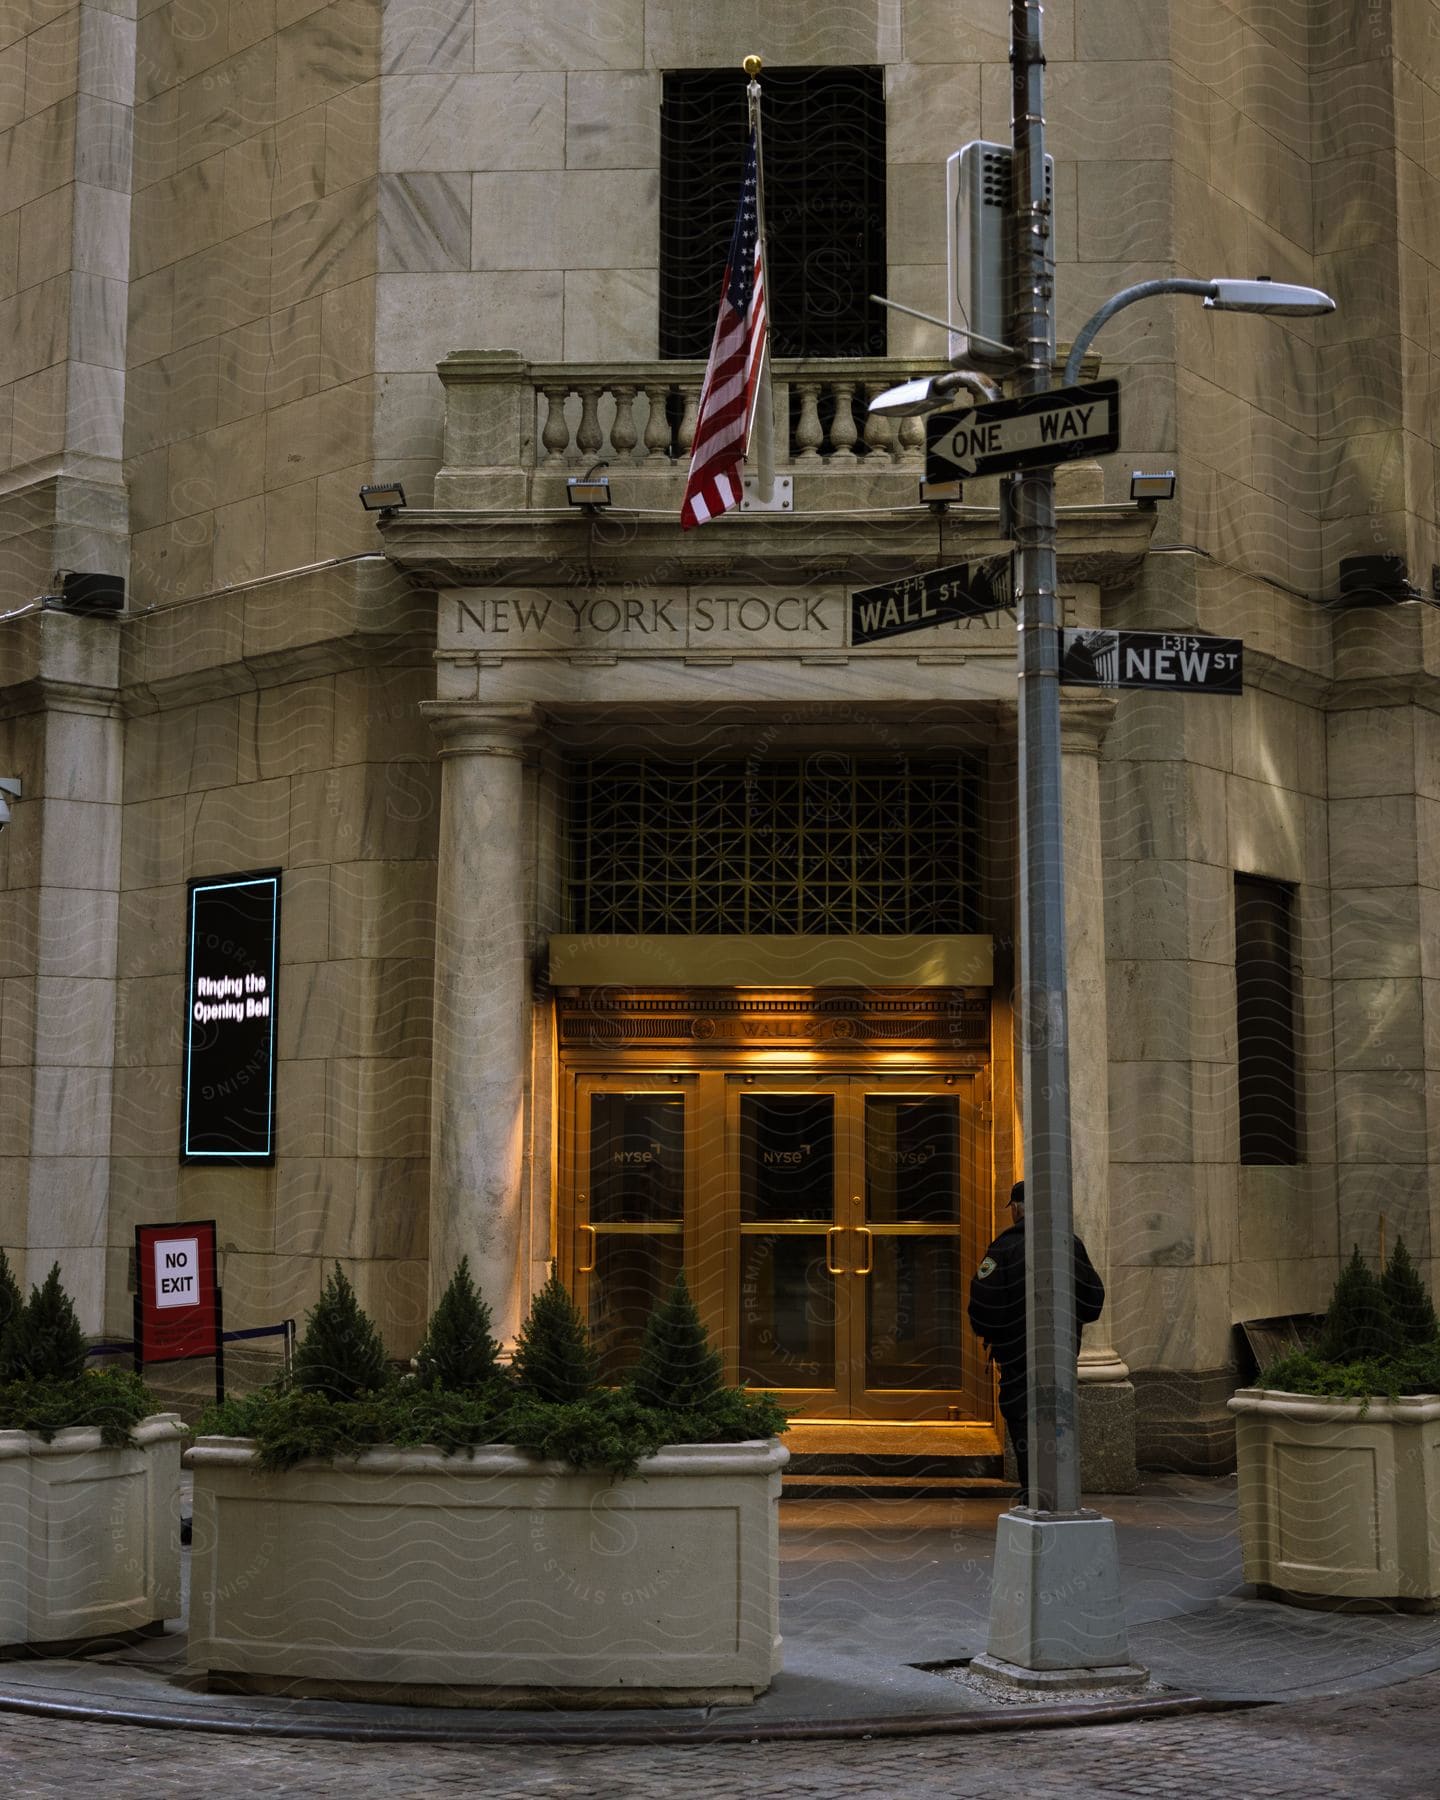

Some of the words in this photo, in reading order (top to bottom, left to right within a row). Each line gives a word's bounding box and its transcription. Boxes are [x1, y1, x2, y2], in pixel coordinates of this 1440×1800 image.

[952, 425, 1002, 458] ONE
[1040, 406, 1094, 442] WAY
[456, 597, 552, 634] NEW
[565, 597, 678, 634] YORK
[694, 597, 830, 634] STOCK
[860, 589, 937, 633] WALL
[940, 580, 960, 600] ST
[1162, 636, 1186, 652] 1-31
[1126, 648, 1210, 682] NEW
[1214, 654, 1238, 670] ST
[198, 975, 242, 999] Ringing
[246, 973, 266, 992] the
[194, 1000, 244, 1024] Opening
[246, 996, 270, 1018] Bell
[741, 1022, 798, 1037] WALL
[166, 1252, 188, 1269] NO
[162, 1276, 194, 1294] EXIT
